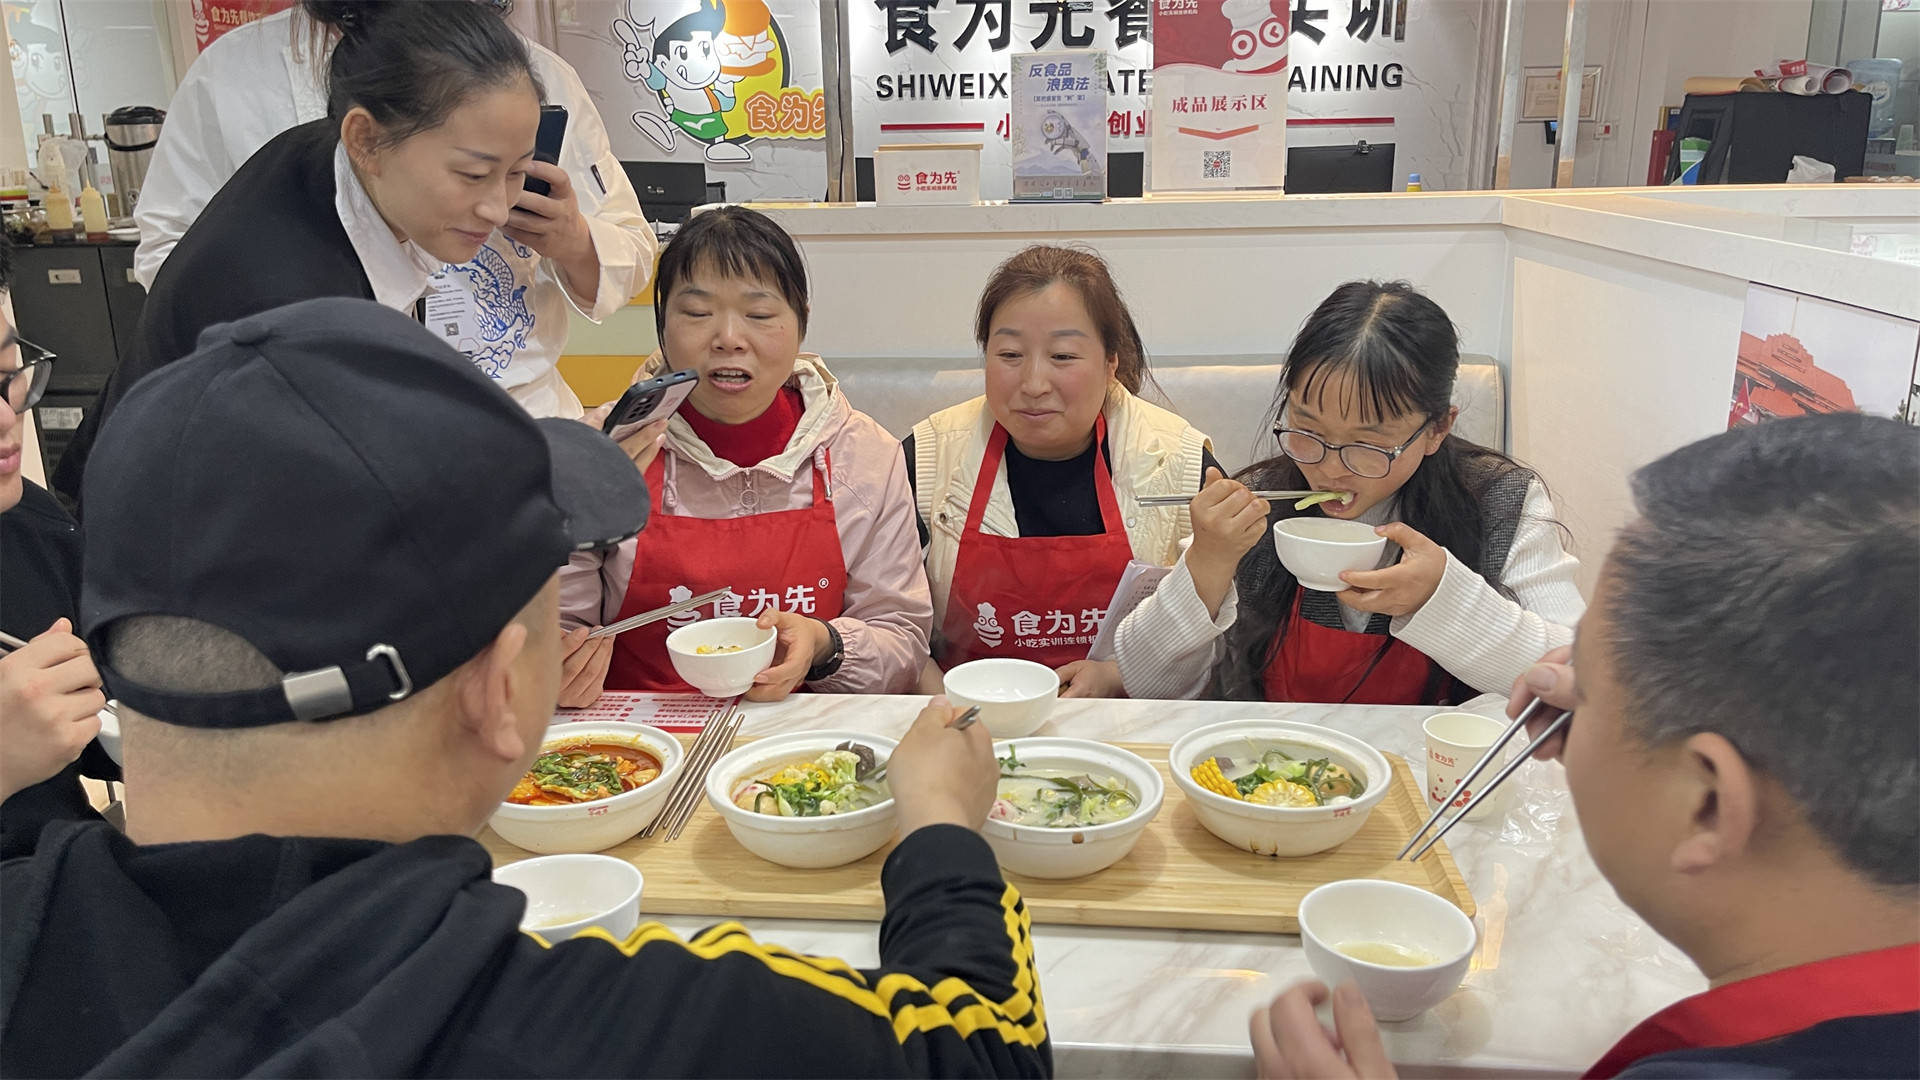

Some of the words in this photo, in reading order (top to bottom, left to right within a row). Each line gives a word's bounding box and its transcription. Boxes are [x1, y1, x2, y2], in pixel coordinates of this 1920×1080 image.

[1029, 63, 1072, 77] 反食品
[876, 72, 1009, 100] SHIWEIX
[1287, 63, 1403, 92] AINING
[1046, 77, 1090, 92] 浪费法
[1172, 94, 1268, 113] 成品展示区
[915, 171, 957, 185] 食为先
[1011, 607, 1108, 637] 食为先
